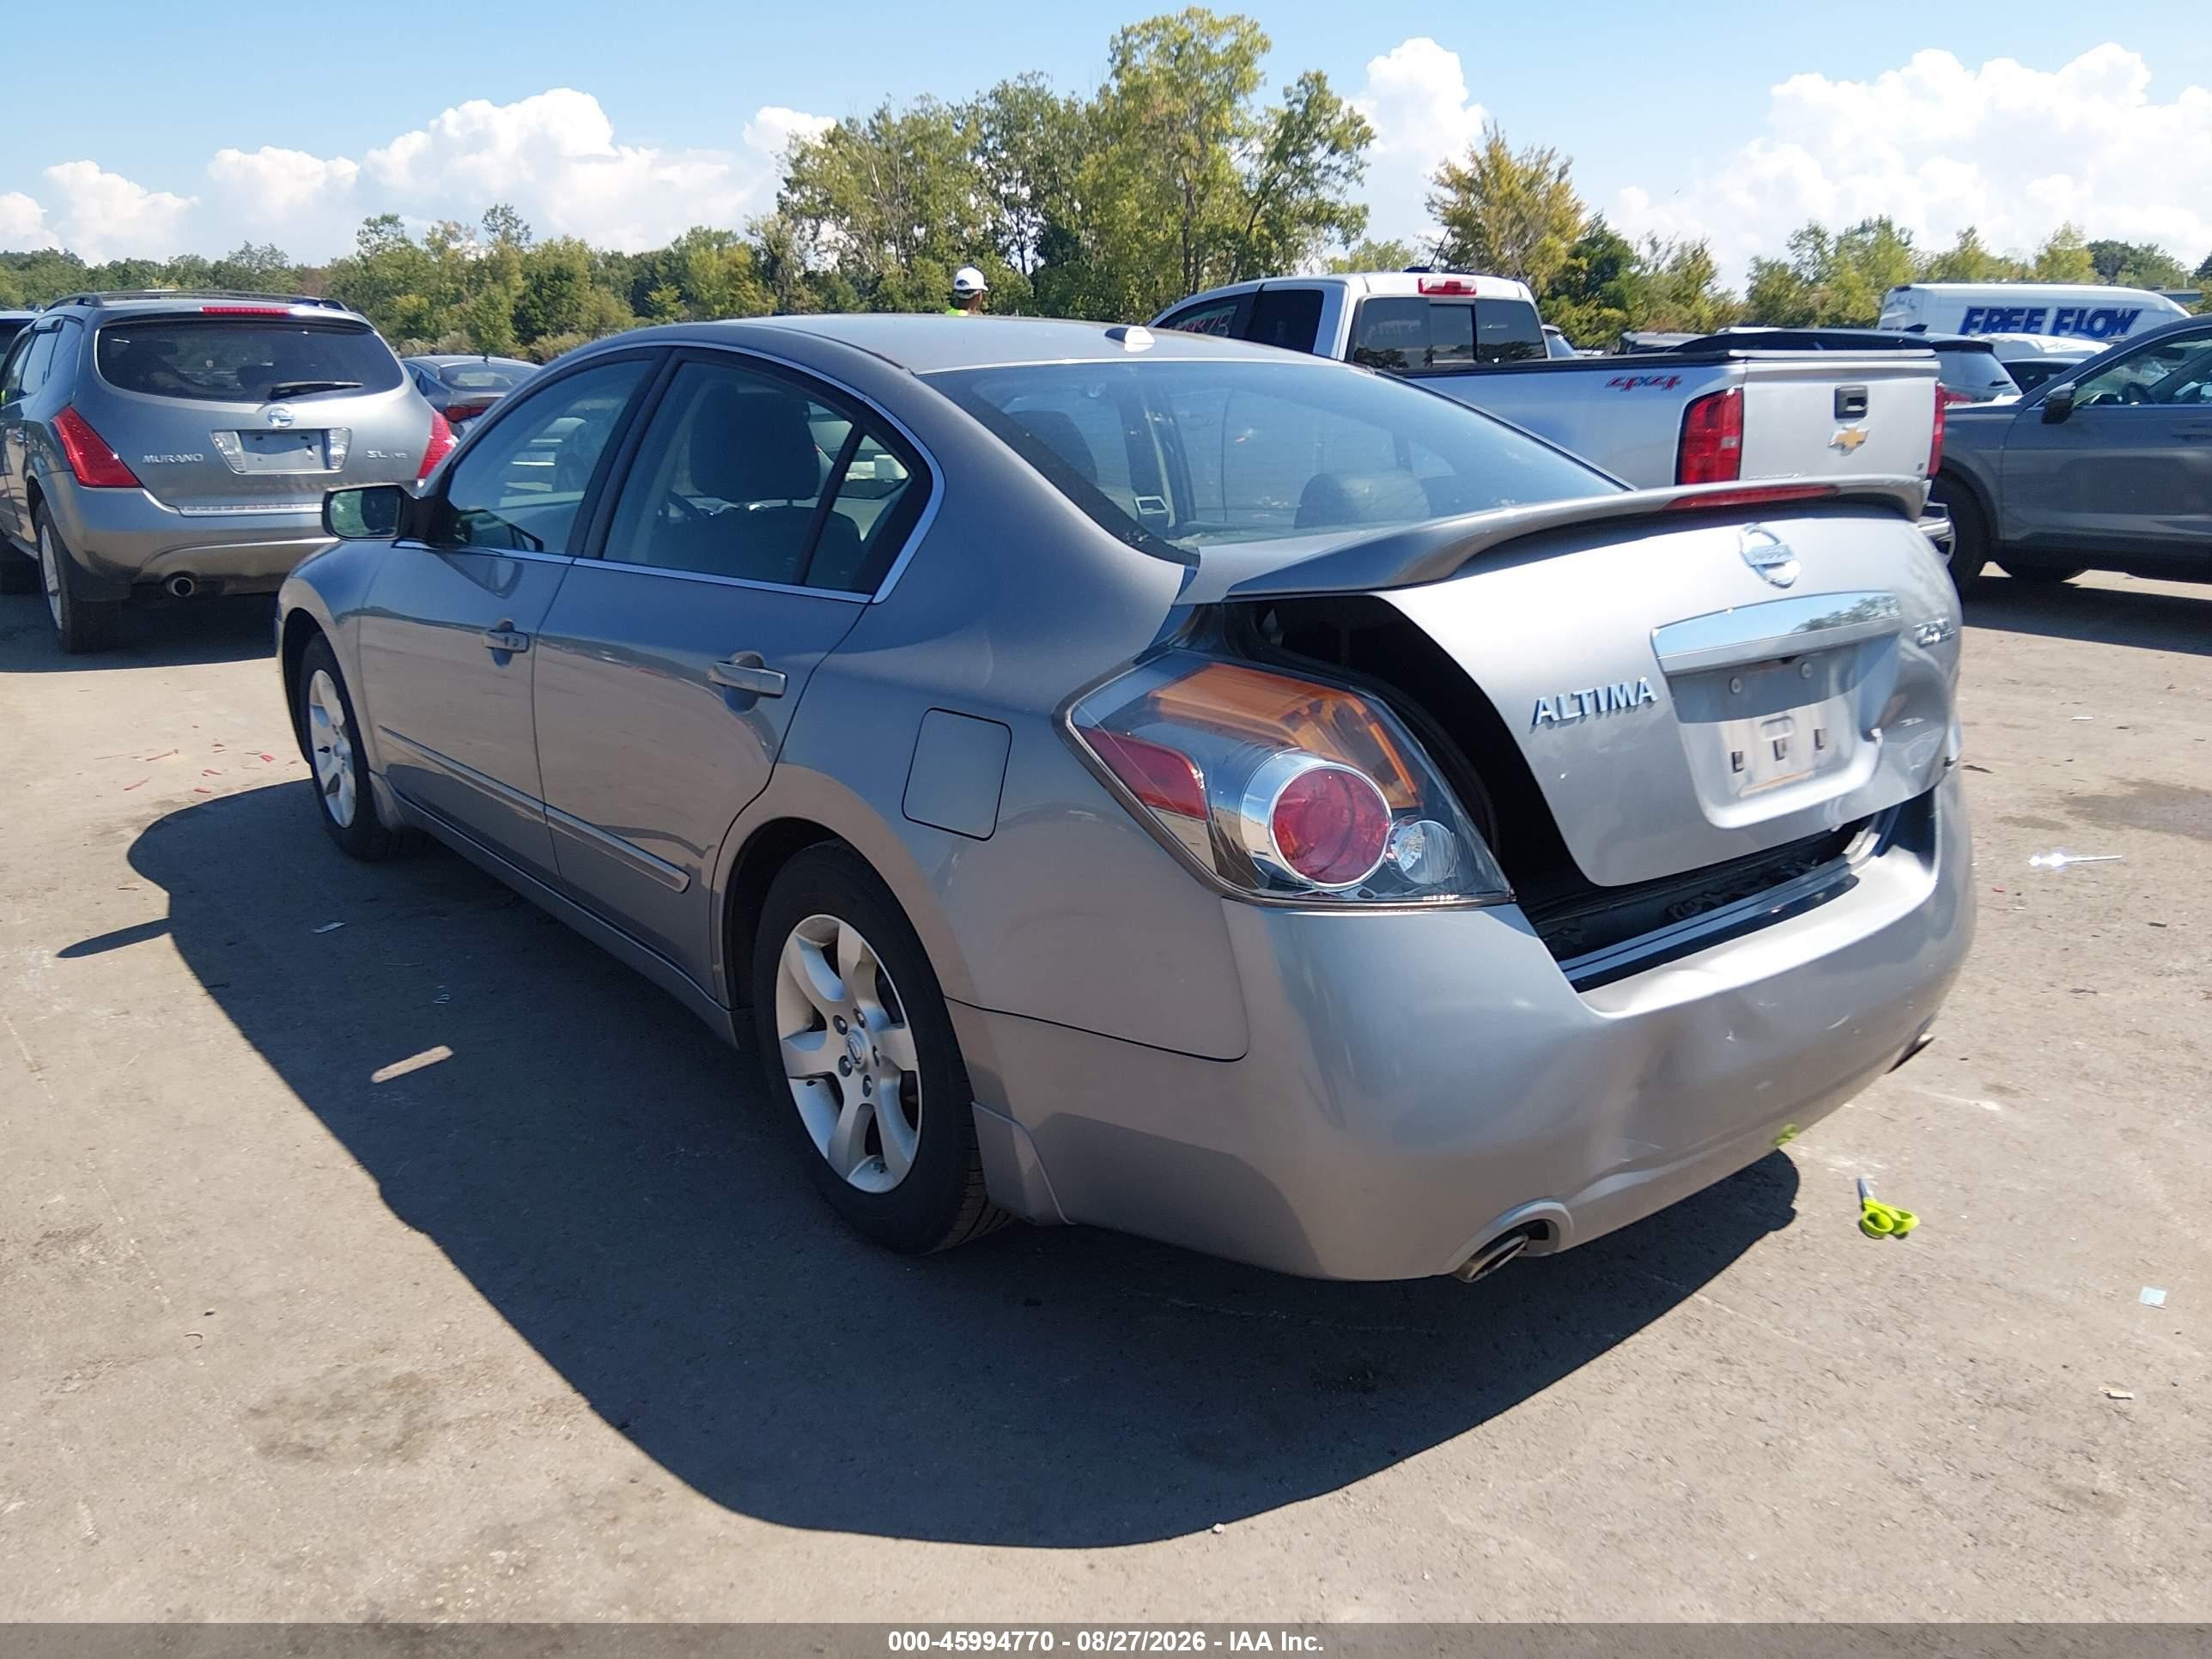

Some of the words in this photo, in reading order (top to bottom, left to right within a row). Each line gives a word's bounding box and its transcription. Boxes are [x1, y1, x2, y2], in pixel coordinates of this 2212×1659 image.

[1958, 306, 2049, 336] FREE
[2051, 307, 2144, 338] FLOW
[143, 453, 204, 464] MURANO
[367, 450, 388, 459] SL
[1532, 677, 1659, 726] ALTIMA
